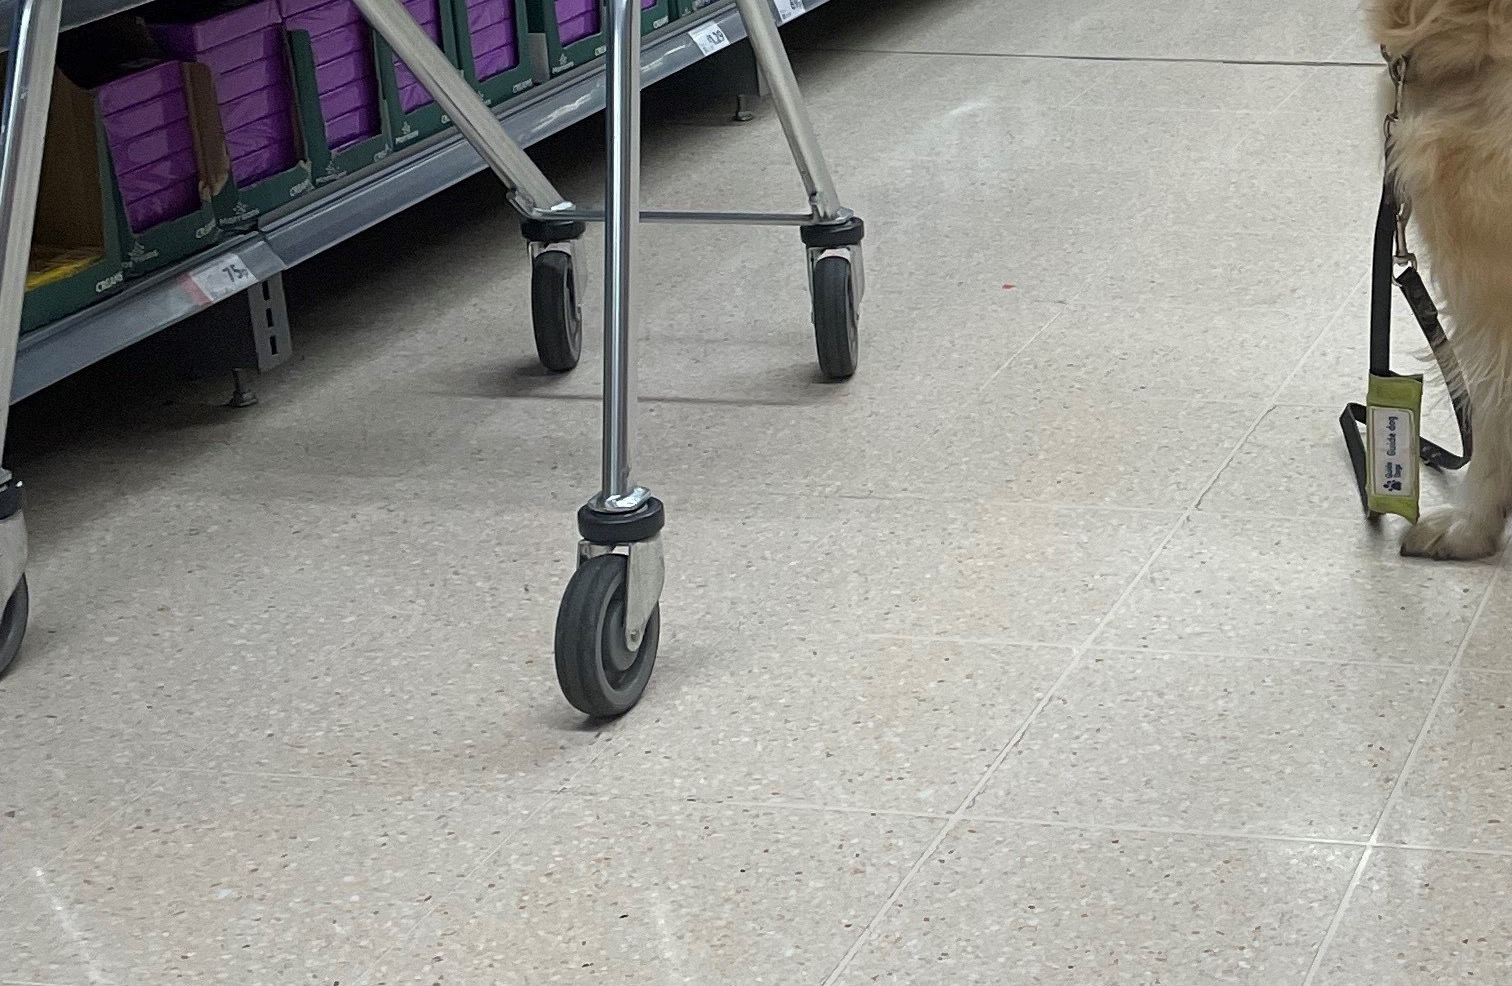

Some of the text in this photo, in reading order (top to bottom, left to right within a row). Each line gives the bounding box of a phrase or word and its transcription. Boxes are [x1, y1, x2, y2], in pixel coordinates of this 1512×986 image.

[221, 263, 250, 284] 75p
[1385, 415, 1399, 457] Guide dog
[1384, 461, 1393, 479] Guide
